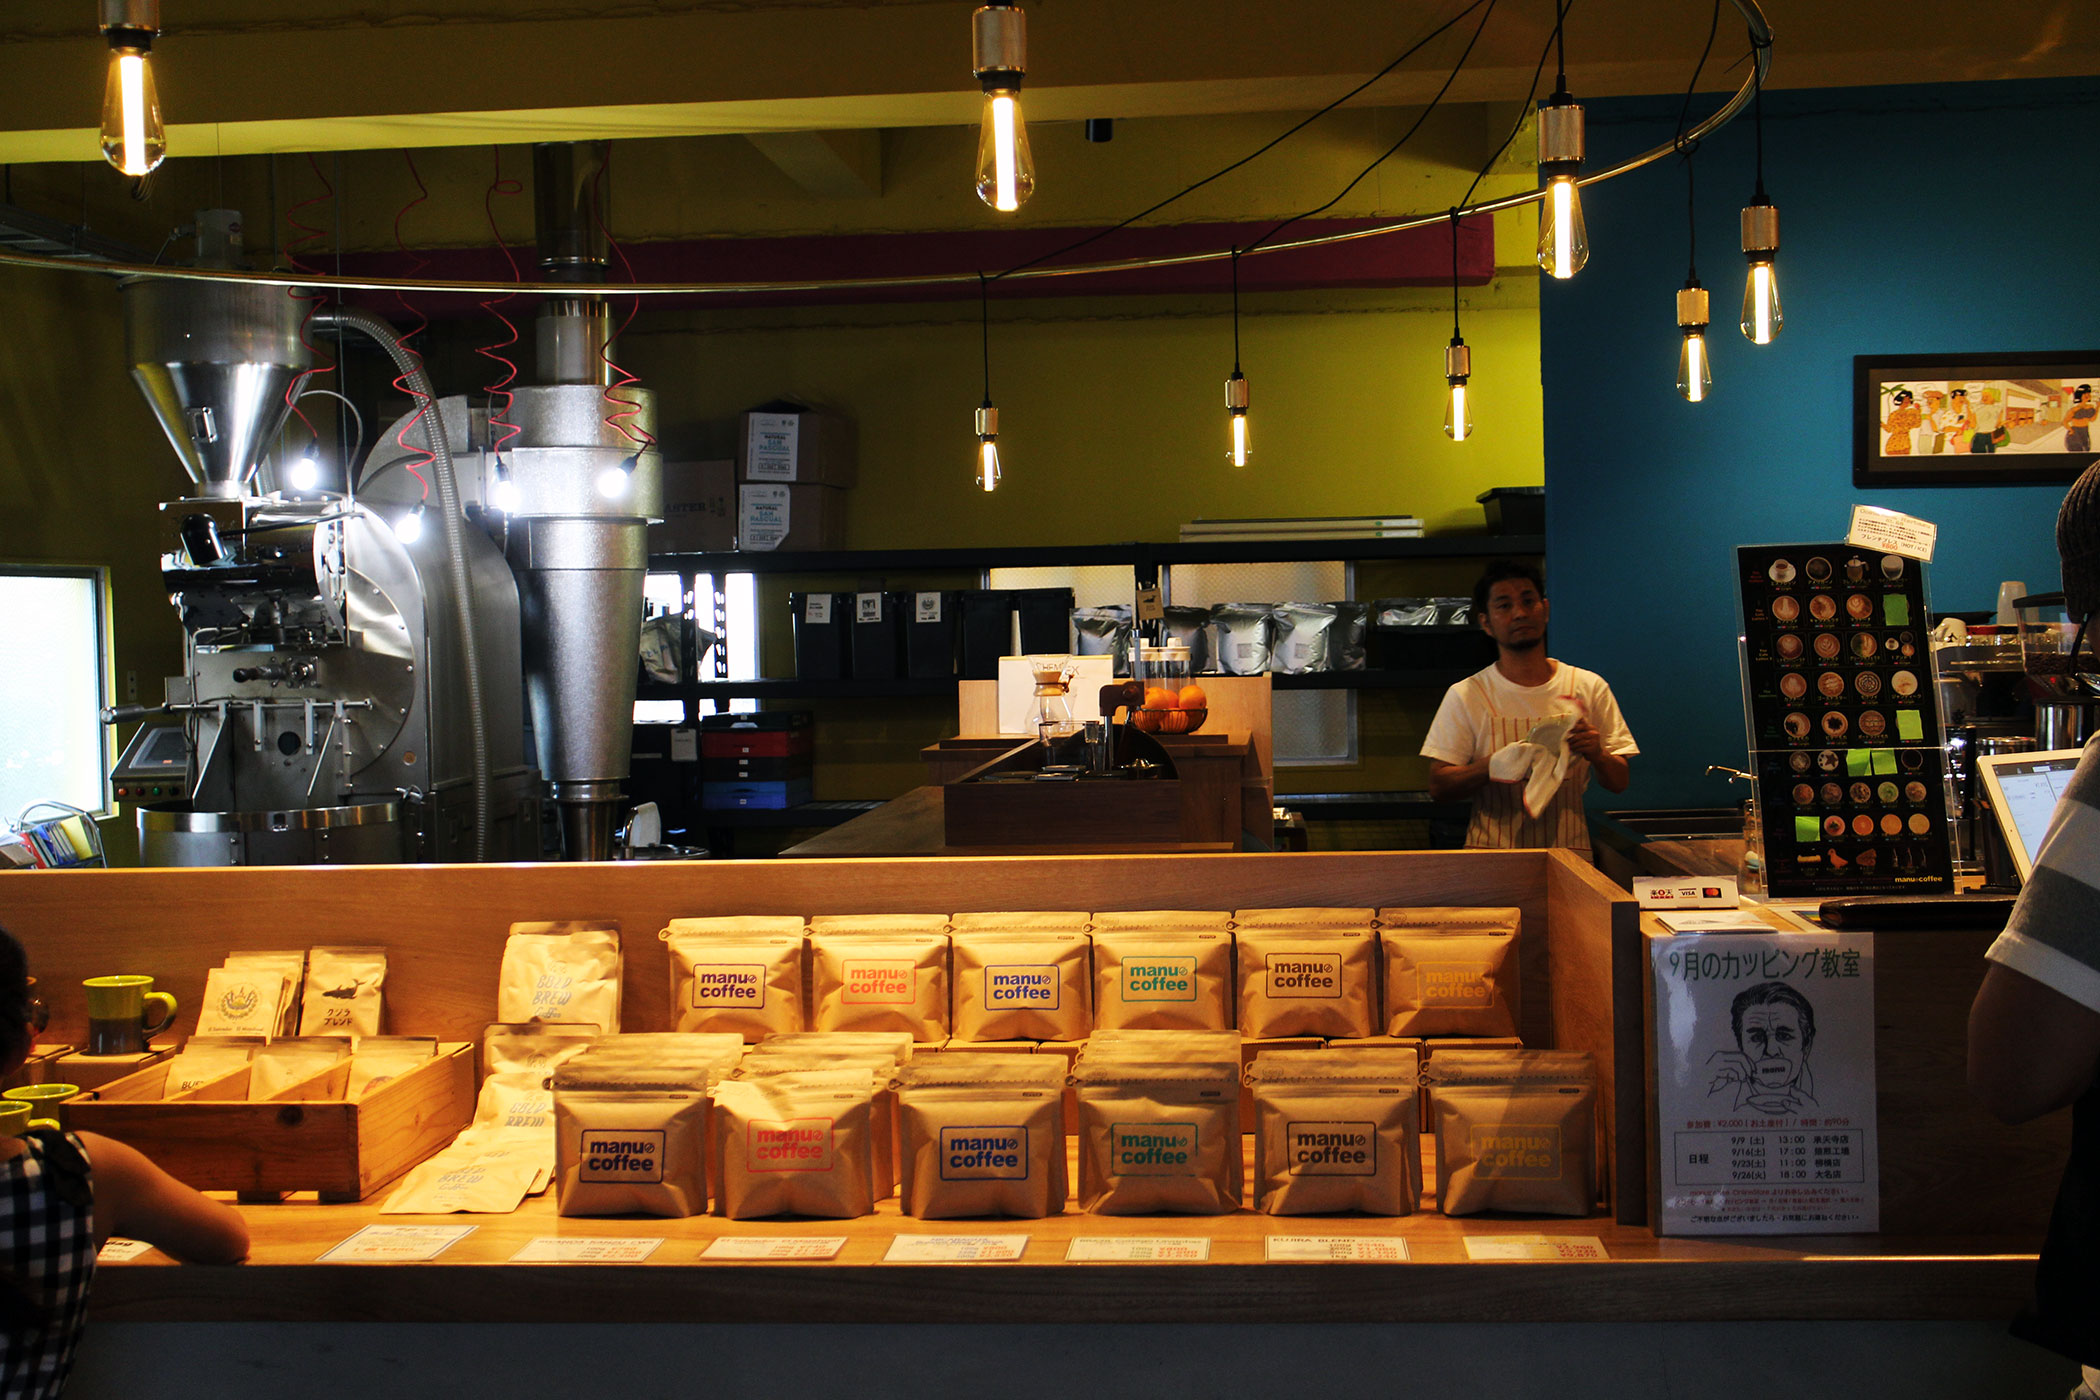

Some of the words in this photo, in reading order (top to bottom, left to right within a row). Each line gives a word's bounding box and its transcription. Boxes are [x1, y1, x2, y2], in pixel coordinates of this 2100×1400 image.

[1130, 965, 1179, 977] manu
[1274, 962, 1324, 974] manu
[1669, 948, 1860, 980] 9月のカッピング教室
[701, 972, 748, 984] manu
[850, 967, 898, 980] manu
[993, 974, 1042, 986] manu
[1274, 973, 1333, 988] coffee
[1426, 970, 1476, 984] manu
[700, 984, 756, 998] coffee
[850, 980, 906, 994] coffee
[1130, 977, 1188, 991] coffee
[1426, 984, 1486, 998] coffee
[532, 991, 572, 1005] BREW
[993, 986, 1050, 1000] coffee
[326, 1008, 351, 1017] クジラ
[324, 1018, 352, 1026] ブレンド
[757, 1128, 814, 1143] manu
[1122, 1134, 1178, 1148] manu
[1297, 1133, 1356, 1146] manu
[1481, 1136, 1540, 1149] manu
[1778, 1136, 1805, 1144] 13:00
[590, 1140, 645, 1154] manu
[951, 1137, 1008, 1150] manu
[756, 1142, 822, 1160] coffee
[1121, 1148, 1188, 1165] coffee
[1298, 1147, 1366, 1164] coffee
[1779, 1147, 1806, 1155] 17:00
[589, 1154, 654, 1171] coffee
[950, 1151, 1018, 1168] coffee
[1481, 1150, 1552, 1167] coffee
[1689, 1154, 1709, 1165] 日程
[1780, 1159, 1806, 1167] 11:00
[1815, 1170, 1841, 1179] 大名店
